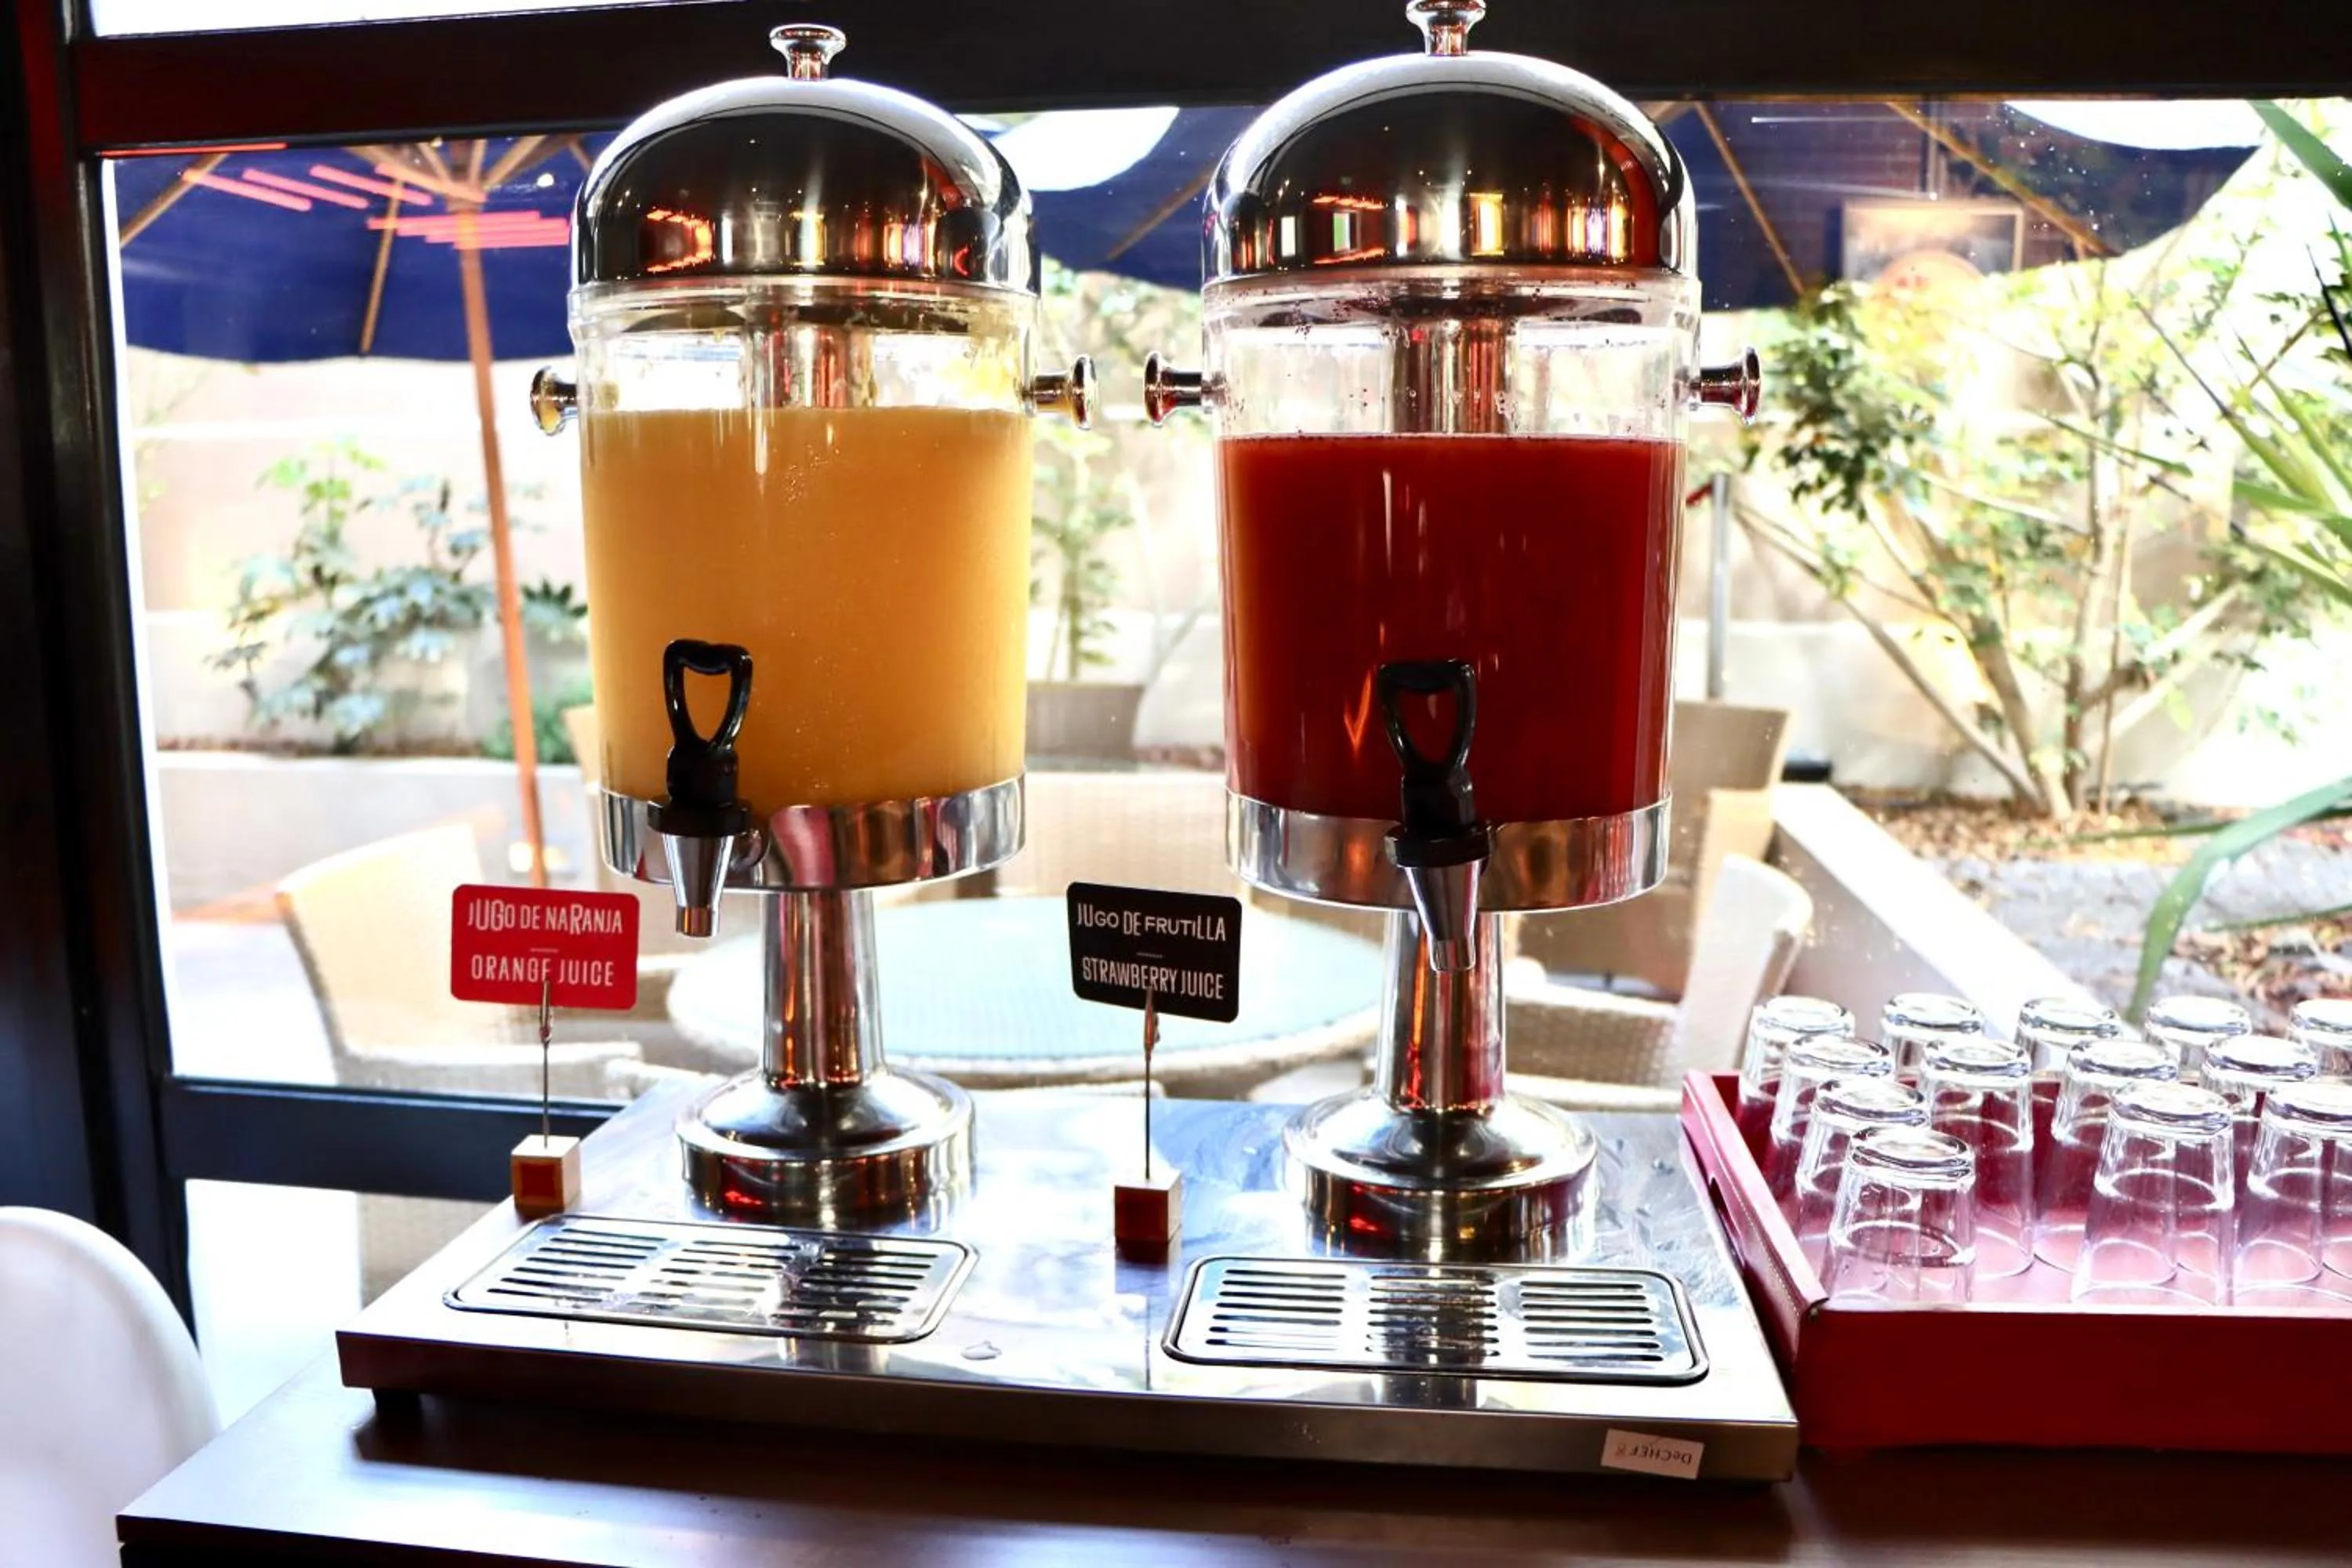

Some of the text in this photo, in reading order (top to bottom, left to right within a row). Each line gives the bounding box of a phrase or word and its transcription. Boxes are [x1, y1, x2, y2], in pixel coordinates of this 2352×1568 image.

[467, 898, 623, 935] JUGO DE NARANJA
[1076, 902, 1119, 928] JUGO
[1123, 910, 1142, 936] DE
[471, 954, 614, 986] ORANGE JUICE
[1082, 956, 1224, 1000] STRAWBERRY JUICE
